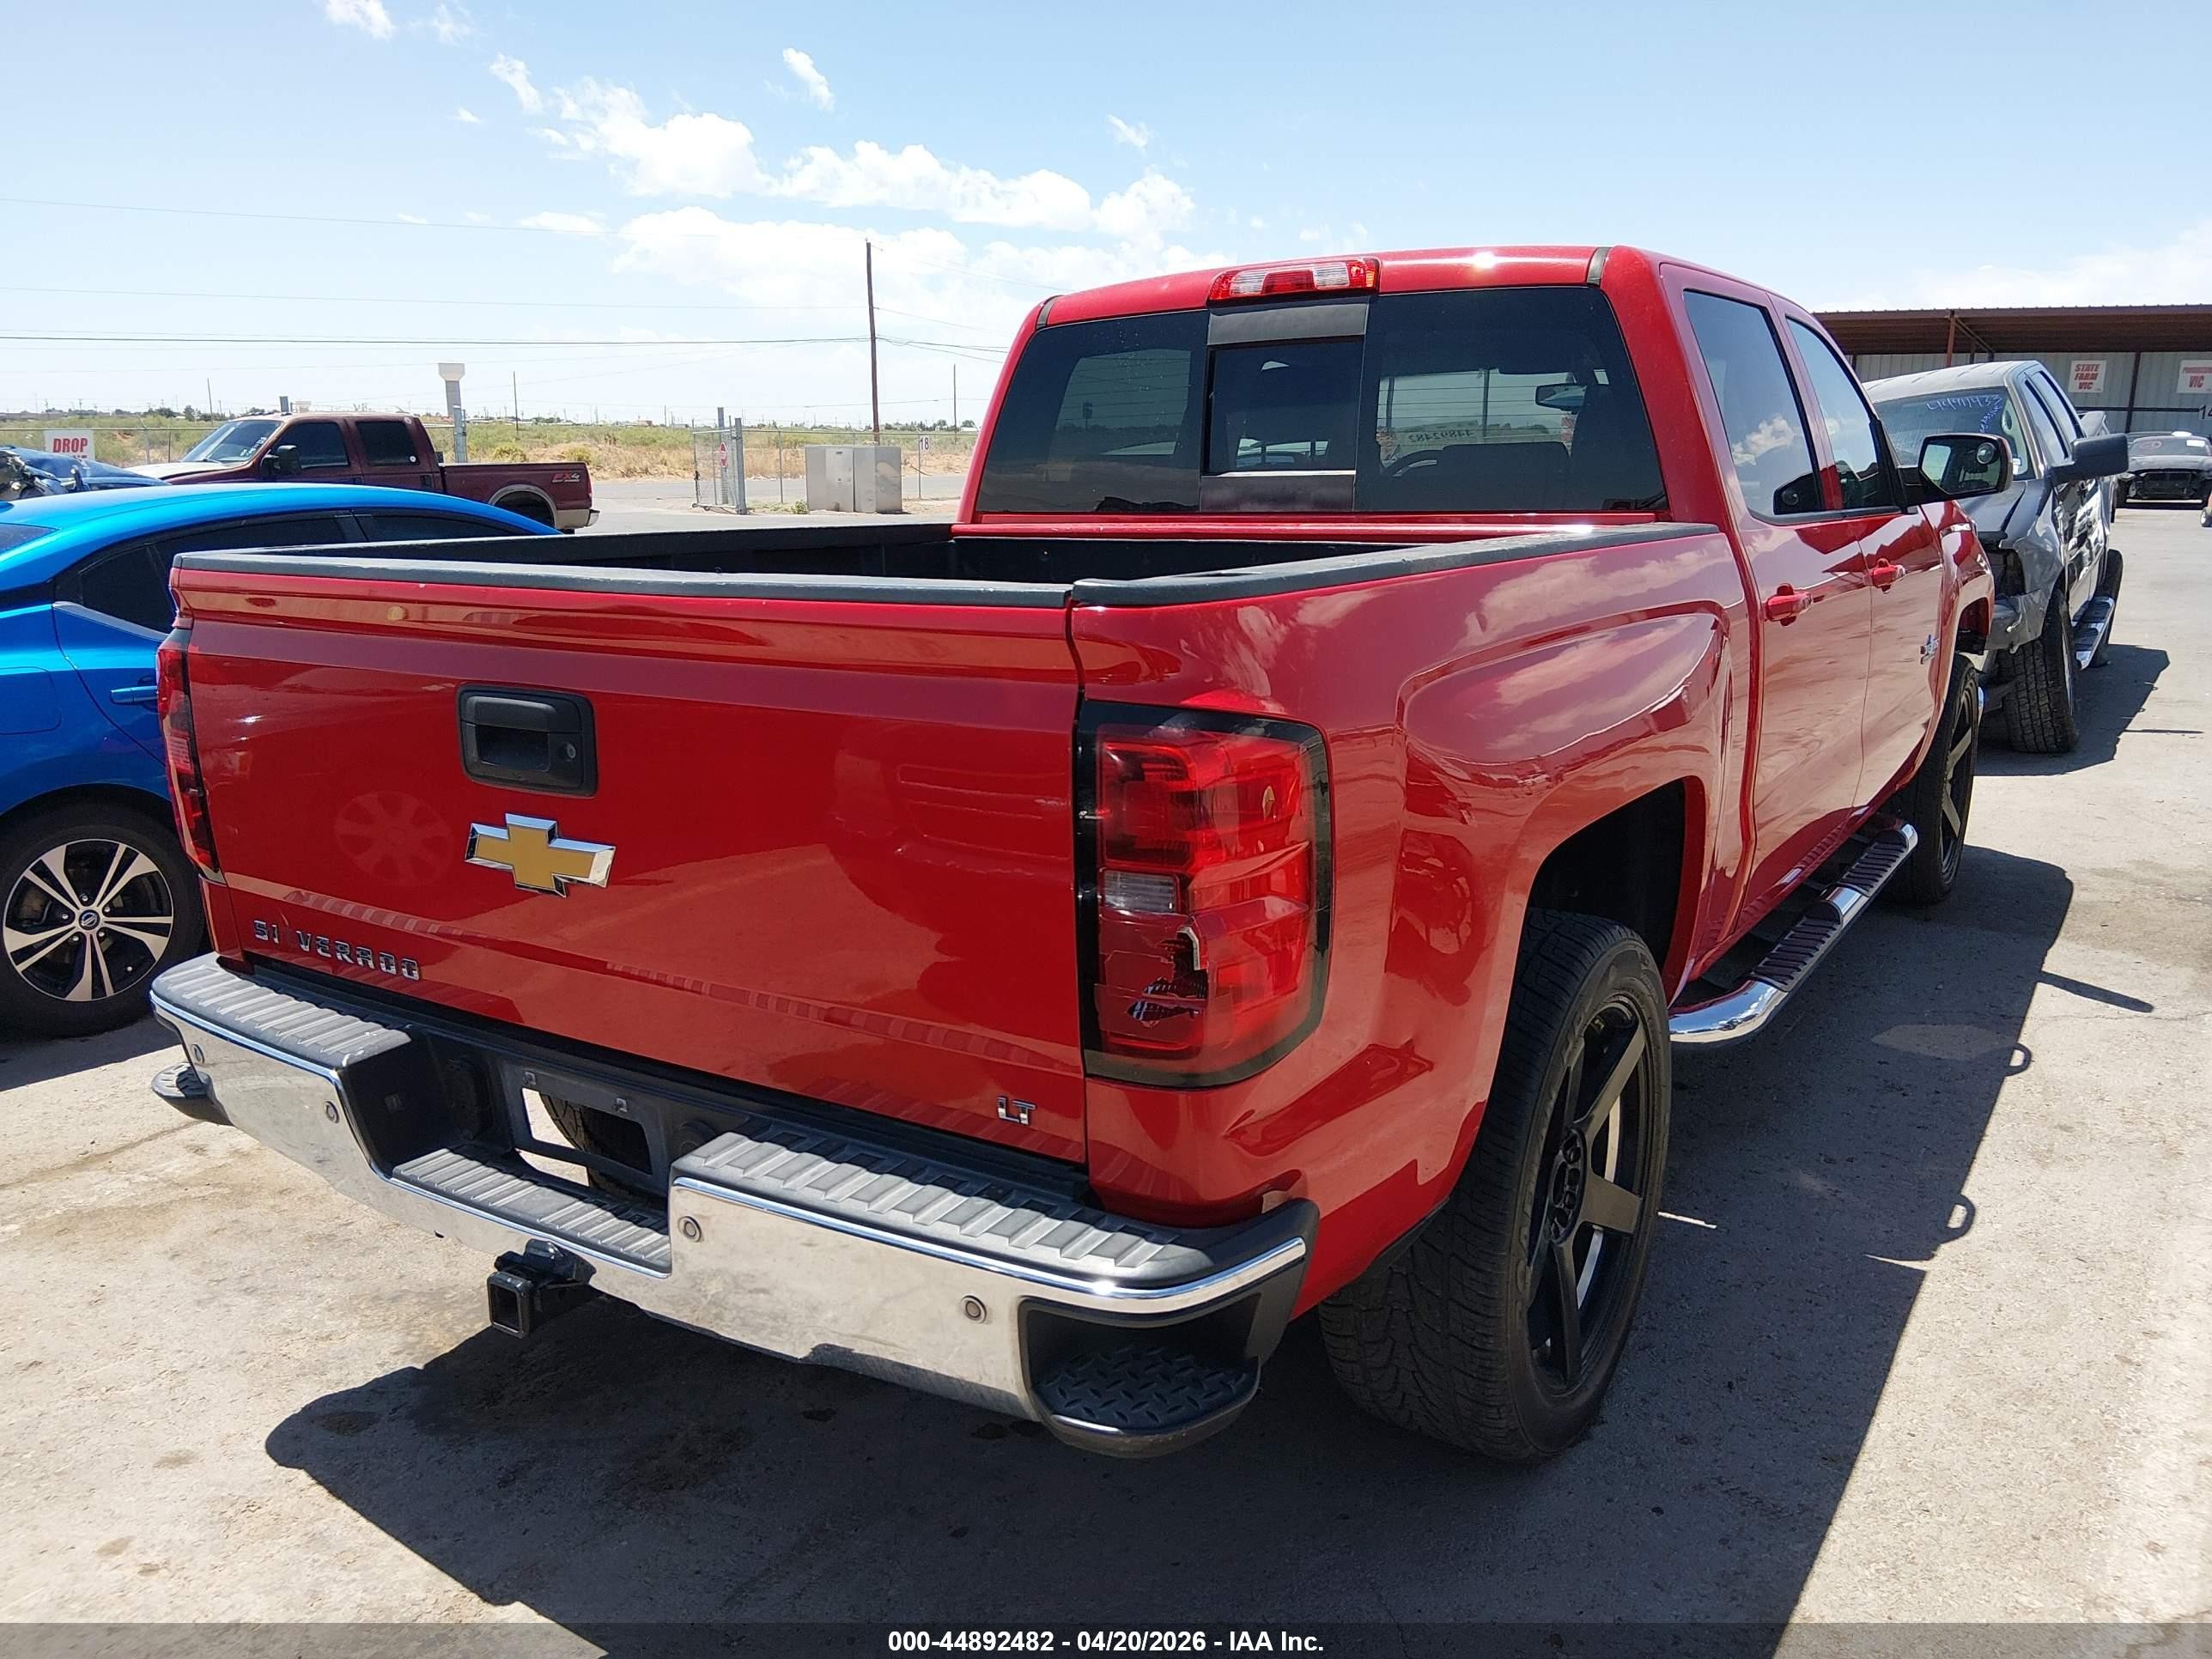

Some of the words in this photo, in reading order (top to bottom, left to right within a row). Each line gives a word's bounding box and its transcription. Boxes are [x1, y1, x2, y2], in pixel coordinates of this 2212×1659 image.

[2075, 364, 2100, 373] STATE
[2078, 381, 2094, 390] VIC
[2189, 375, 2204, 388] VIC
[52, 438, 88, 453] DROP
[920, 437, 929, 450] 18
[997, 1096, 1036, 1125] LT
